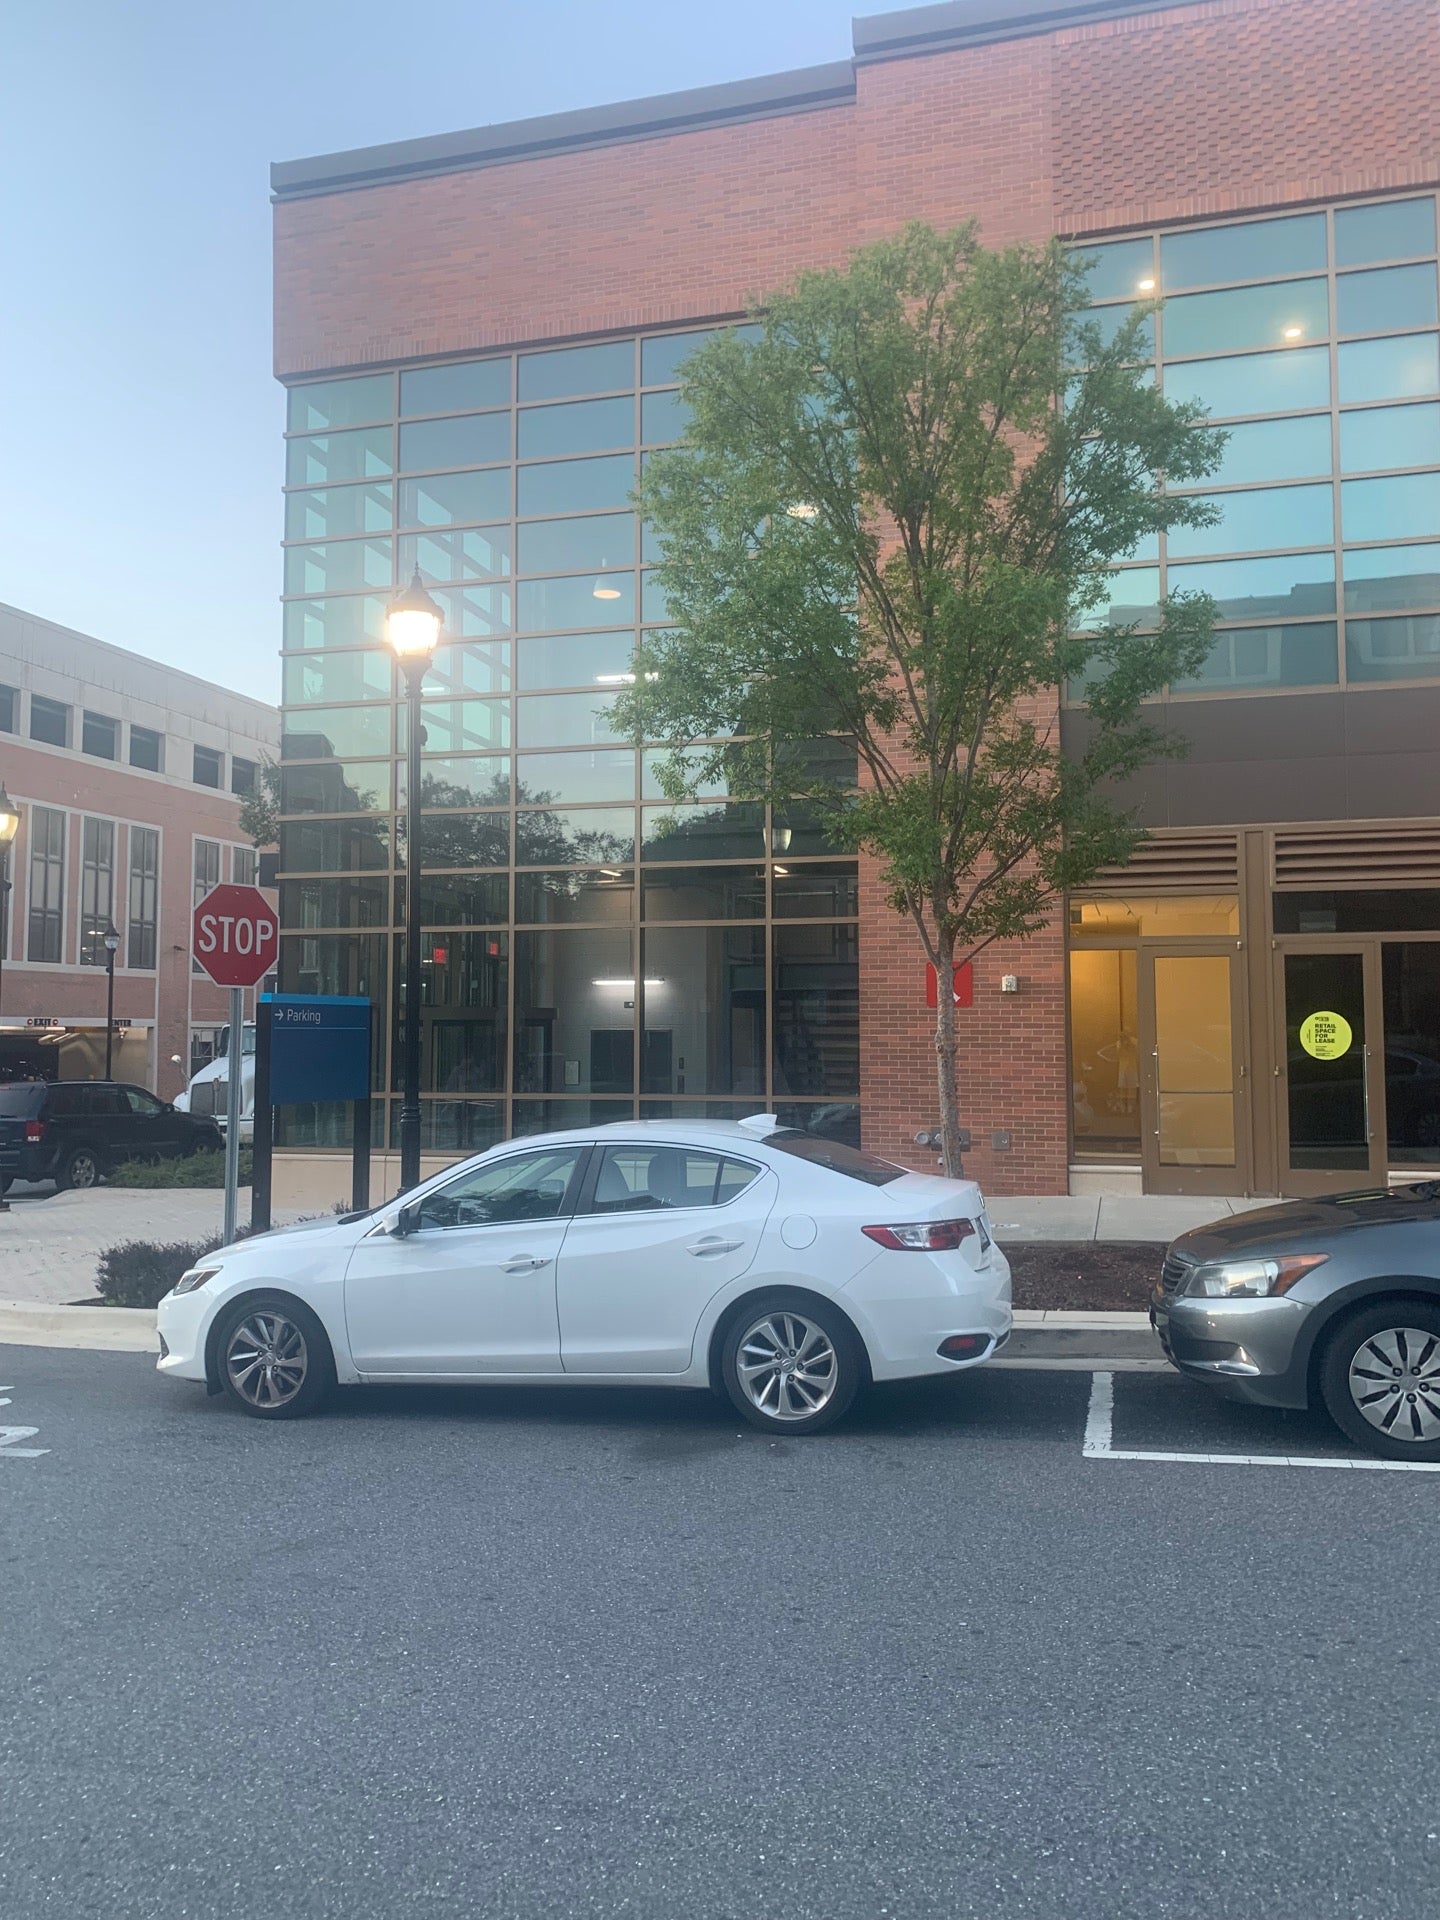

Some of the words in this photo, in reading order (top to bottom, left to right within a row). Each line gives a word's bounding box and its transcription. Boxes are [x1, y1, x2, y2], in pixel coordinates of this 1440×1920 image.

[198, 914, 274, 955] STOP
[33, 1018, 52, 1026] EXIT
[287, 1008, 321, 1025] Parking
